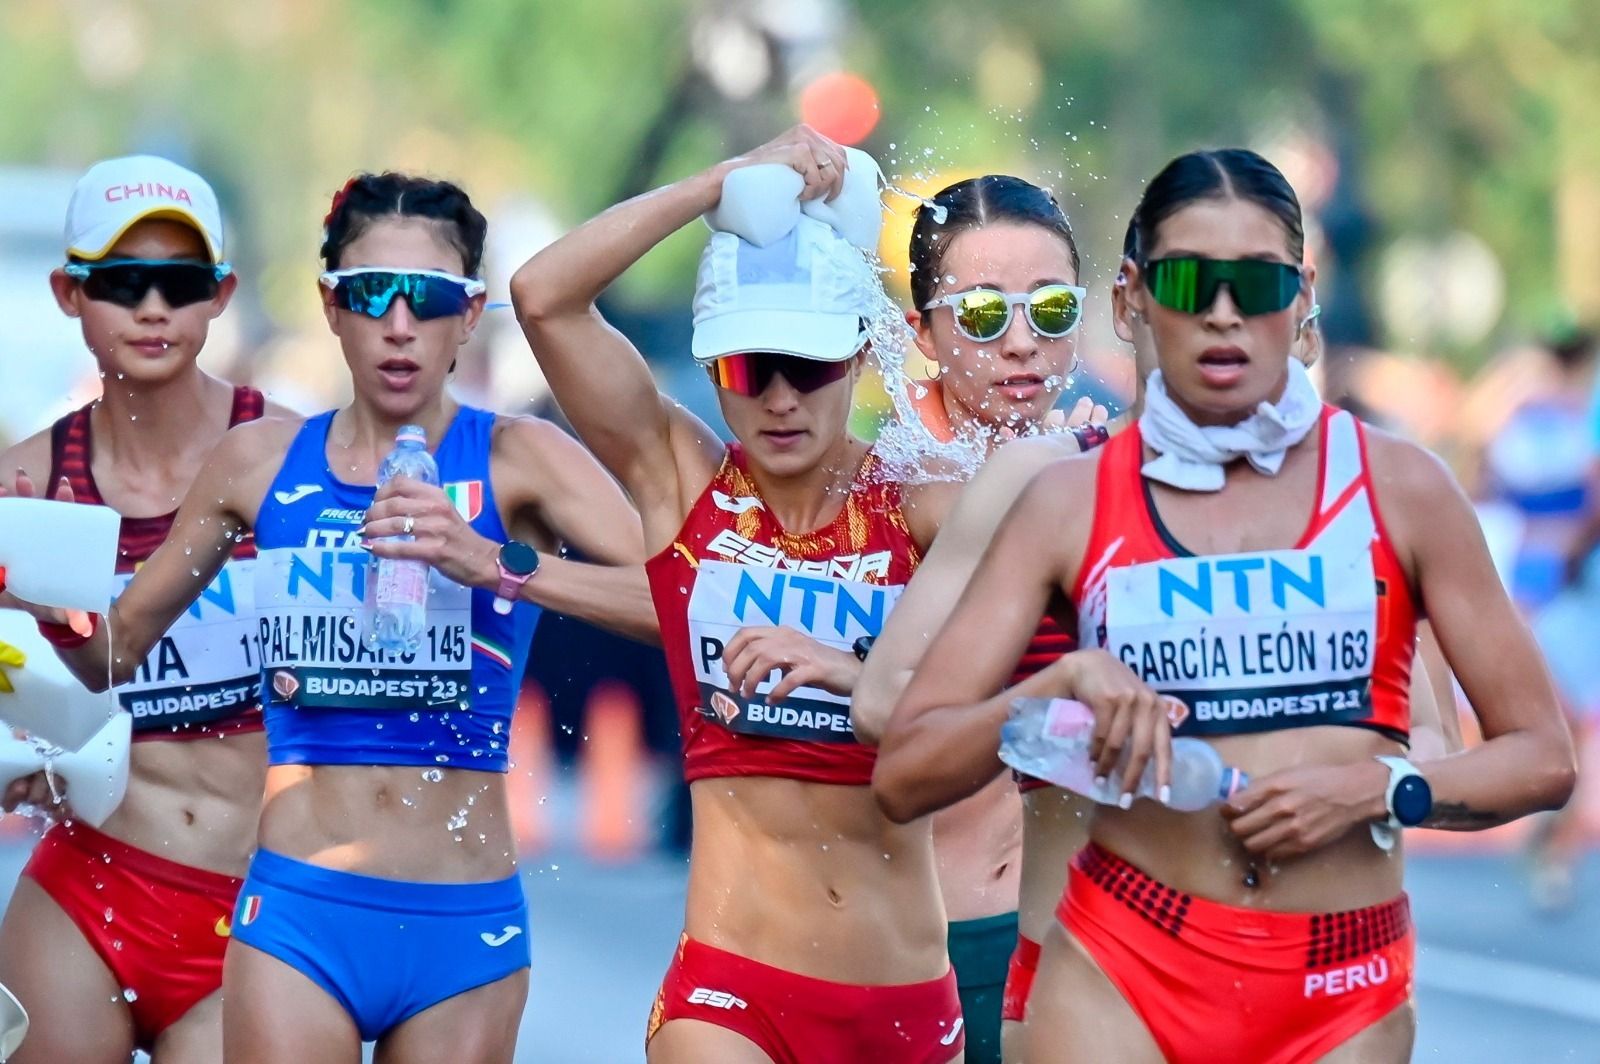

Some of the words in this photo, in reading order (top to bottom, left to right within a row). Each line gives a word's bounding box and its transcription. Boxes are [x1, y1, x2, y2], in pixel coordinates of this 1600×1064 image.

[105, 183, 192, 207] CHINA
[287, 551, 377, 603] NT
[1158, 556, 1325, 618] NTN
[733, 569, 885, 638] NTN
[260, 615, 416, 664] PALMISA
[427, 625, 466, 663] 145
[1119, 624, 1231, 683] GARCÍA
[1240, 622, 1317, 676] LEÓN
[1327, 629, 1369, 673] 163
[131, 686, 249, 718] BUDAPEST
[306, 677, 429, 698] BUDAPEST
[431, 680, 458, 699] 23
[1195, 693, 1329, 721] BUDAPEST
[1304, 954, 1389, 998] PERÚ
[687, 987, 749, 1010] ESP
